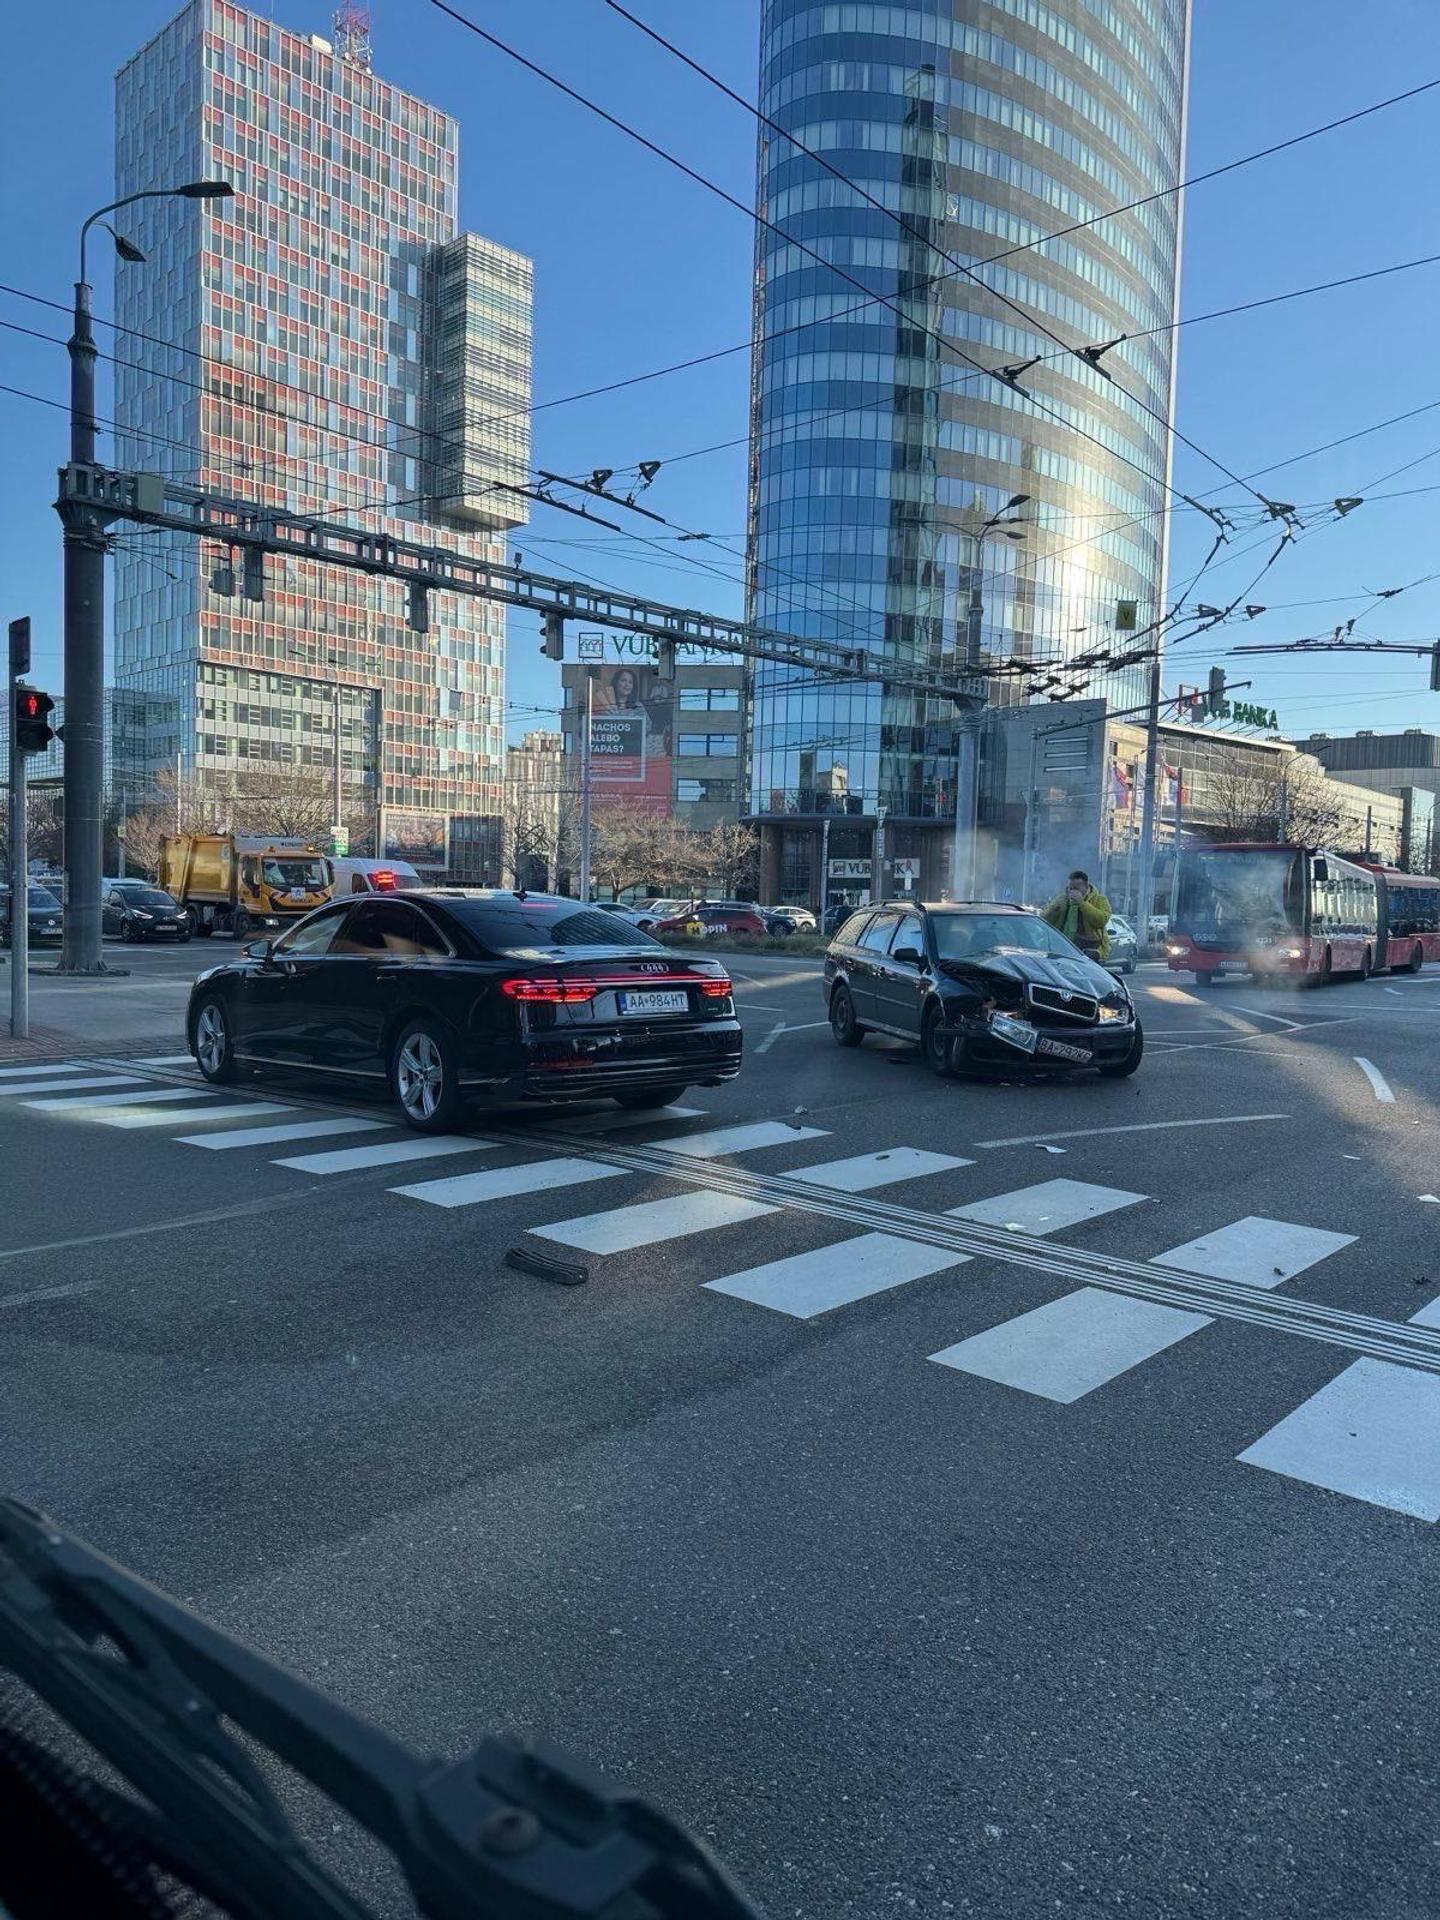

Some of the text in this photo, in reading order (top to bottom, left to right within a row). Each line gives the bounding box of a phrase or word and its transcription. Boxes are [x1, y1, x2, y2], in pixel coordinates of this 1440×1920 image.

[1233, 701, 1279, 730] BANKA
[591, 723, 631, 732] NACHOS
[591, 734, 620, 743] ALEBO
